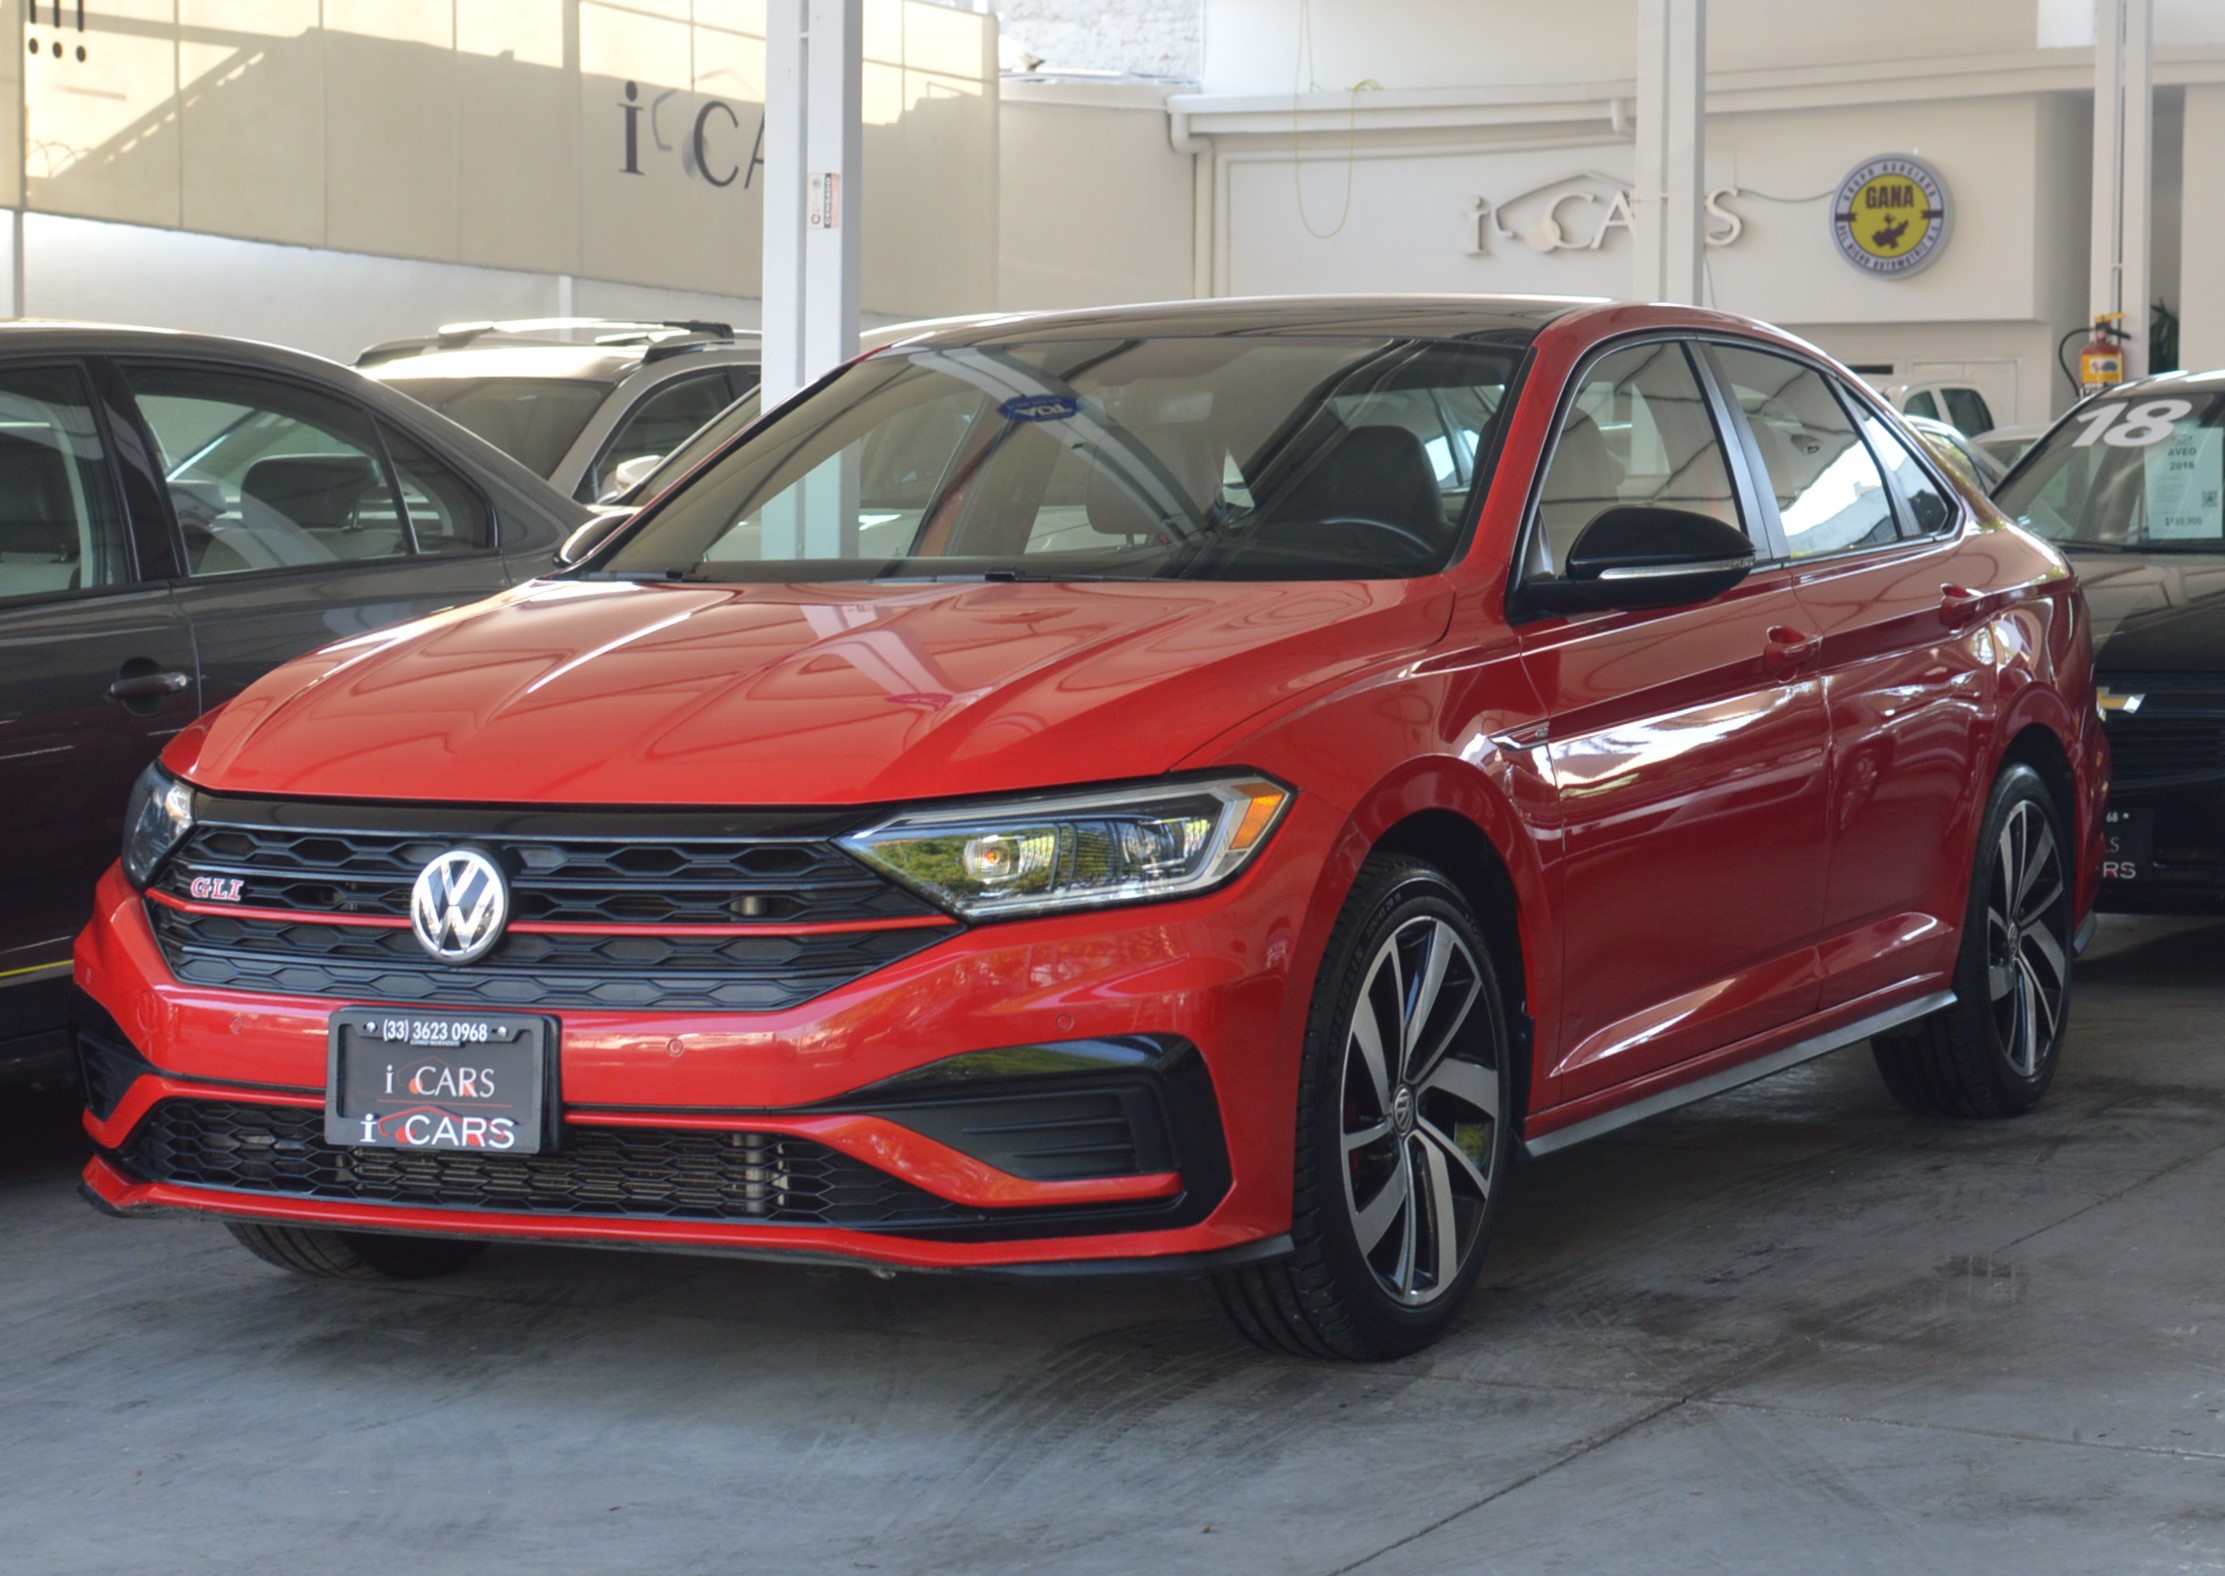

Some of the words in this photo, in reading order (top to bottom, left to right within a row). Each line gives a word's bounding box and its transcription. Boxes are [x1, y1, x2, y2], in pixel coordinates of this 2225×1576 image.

[1865, 184, 1914, 209] GANA
[1545, 189, 1742, 249] CAS
[2071, 399, 2192, 447] 18
[2168, 447, 2197, 456] AVEO
[190, 876, 244, 901] GLI
[383, 1018, 409, 1042] (33)
[412, 1021, 448, 1041] 3623
[451, 1023, 488, 1042] 0968
[414, 1066, 495, 1098] CARS
[360, 1113, 377, 1143] i
[404, 1114, 515, 1149] CARS
